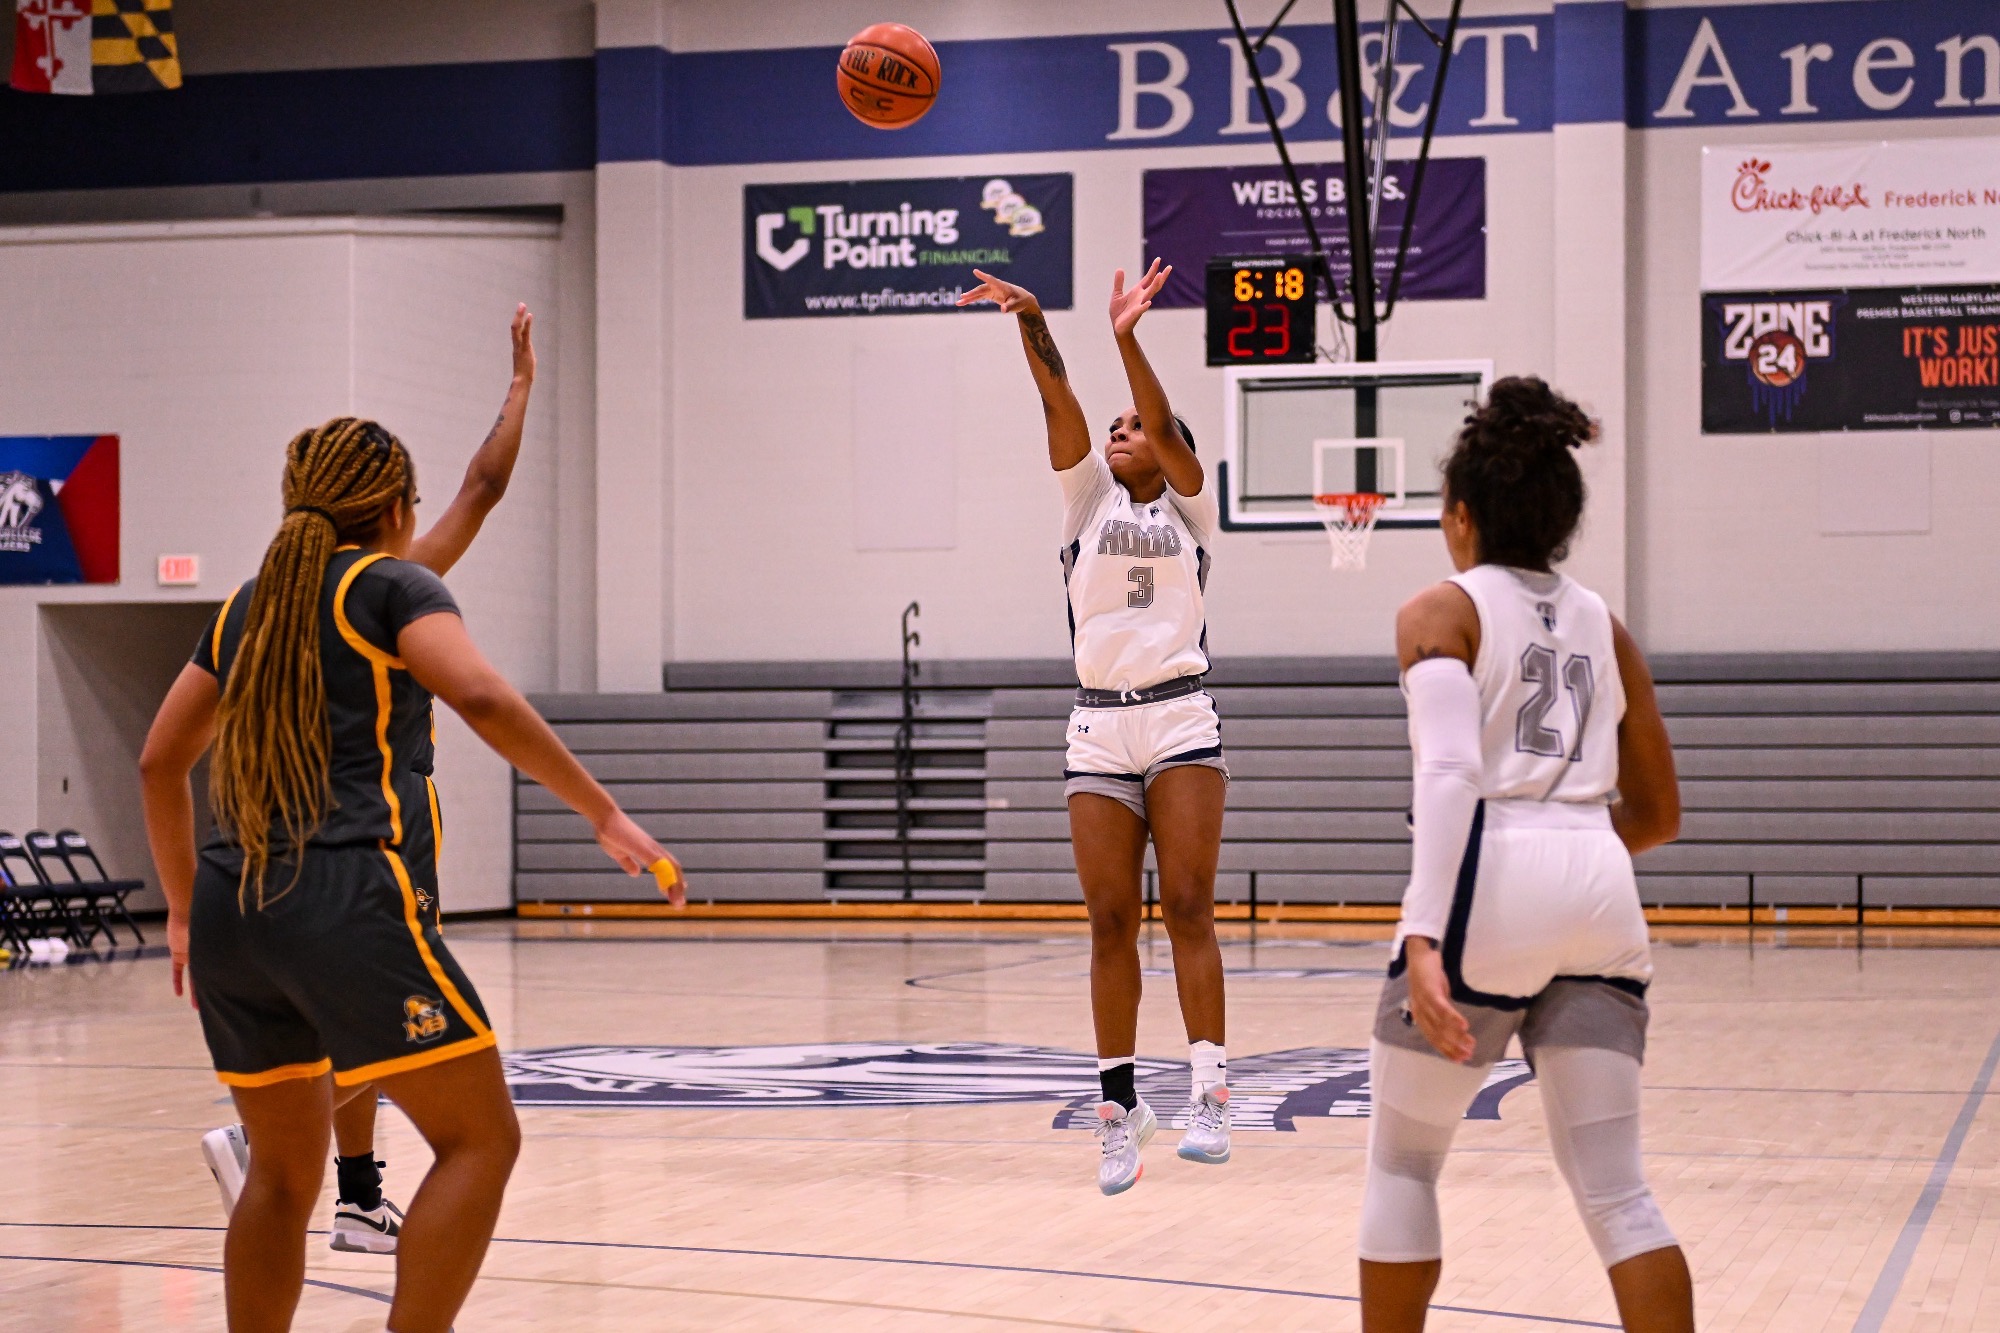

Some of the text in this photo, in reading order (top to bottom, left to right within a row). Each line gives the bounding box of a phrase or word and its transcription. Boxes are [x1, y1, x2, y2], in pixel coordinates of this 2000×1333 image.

[876, 55, 919, 89] ROCK
[1105, 16, 2000, 141] BB&T Aren
[1232, 175, 1406, 206] WEISS BS.
[1884, 188, 1977, 208] Frederick
[816, 202, 959, 244] Turning
[1879, 227, 1942, 241] Frederick
[1946, 225, 1986, 240] North
[823, 236, 1013, 270] Point FINANCIAL
[1234, 267, 1304, 302] 6:18
[1900, 293, 1949, 306] WESTERN
[1856, 306, 1900, 319] PREMIER
[1901, 304, 1964, 318] BASKETBALL
[1227, 303, 1291, 357] 23
[1722, 300, 1831, 360] ZONE
[1903, 322, 2000, 358] IT'S JUS
[1758, 342, 1797, 375] 24
[1097, 519, 1183, 559] HOOD
[164, 557, 193, 581] EXIT
[1127, 566, 1154, 608] 3
[1515, 642, 1596, 762] 21
